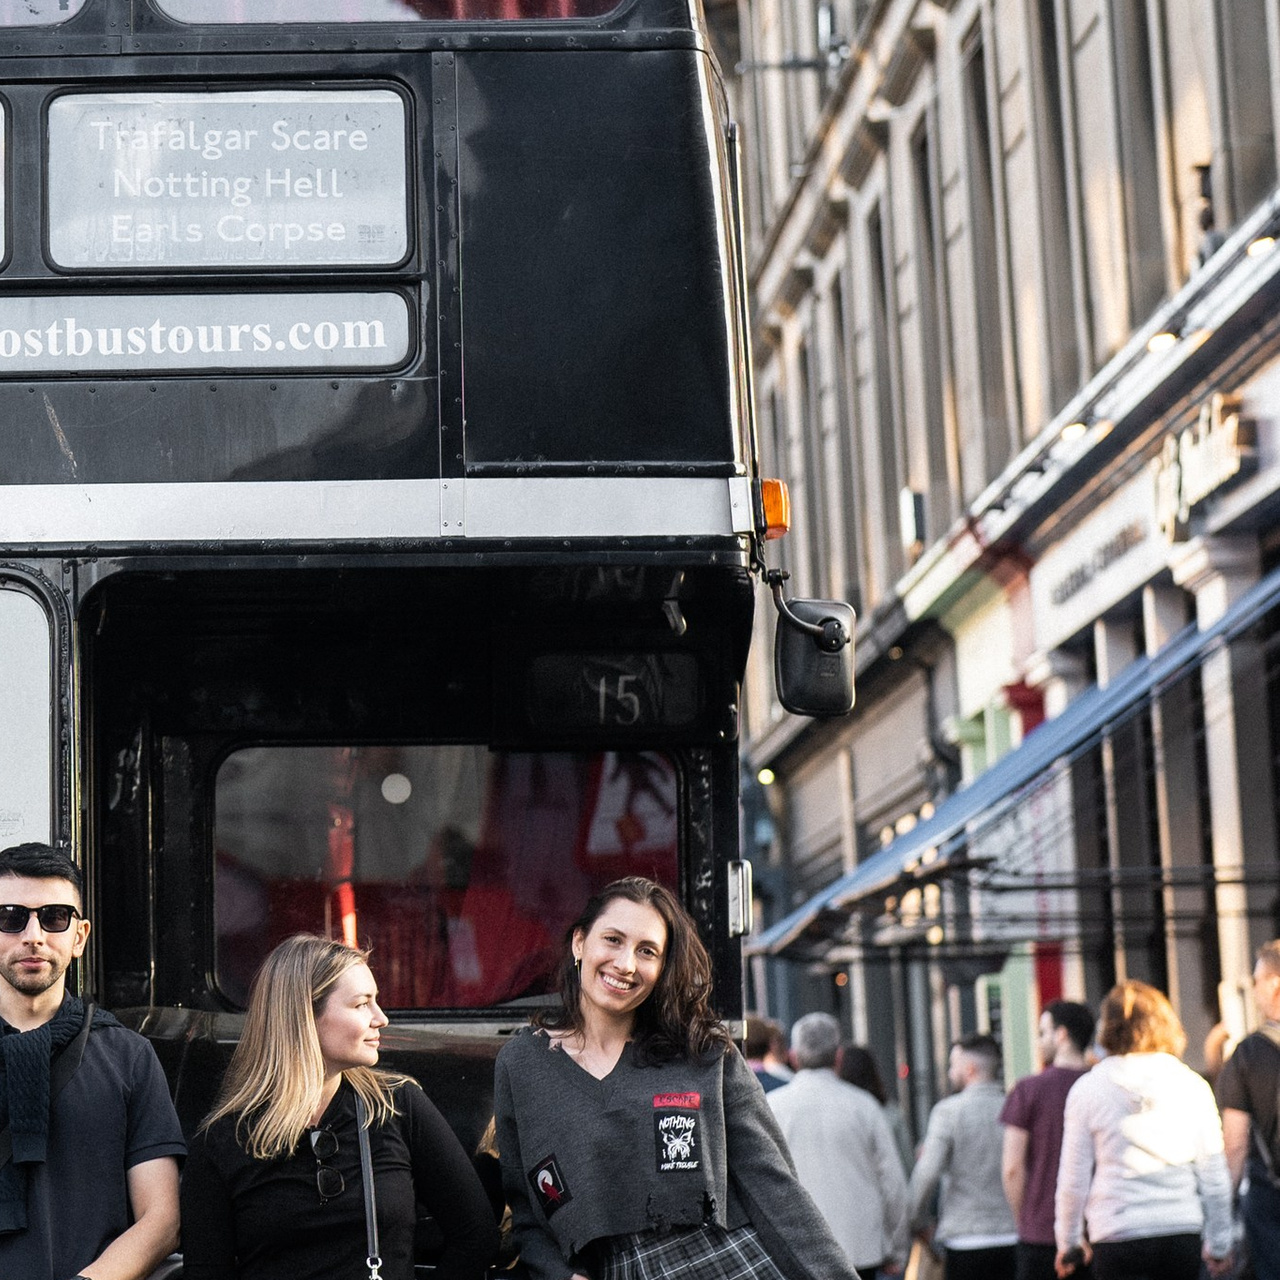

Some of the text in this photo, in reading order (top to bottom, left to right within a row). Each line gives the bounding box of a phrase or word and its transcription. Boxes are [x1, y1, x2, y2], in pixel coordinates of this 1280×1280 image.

[90, 120, 368, 160] Trafalgar Scare
[113, 168, 344, 207] Notting Hell
[111, 214, 203, 243] Earls
[217, 214, 347, 249] Corpse
[598, 674, 641, 725] 15
[658, 1115, 696, 1131] NOTHING
[676, 1161, 699, 1169] TROUBLE
